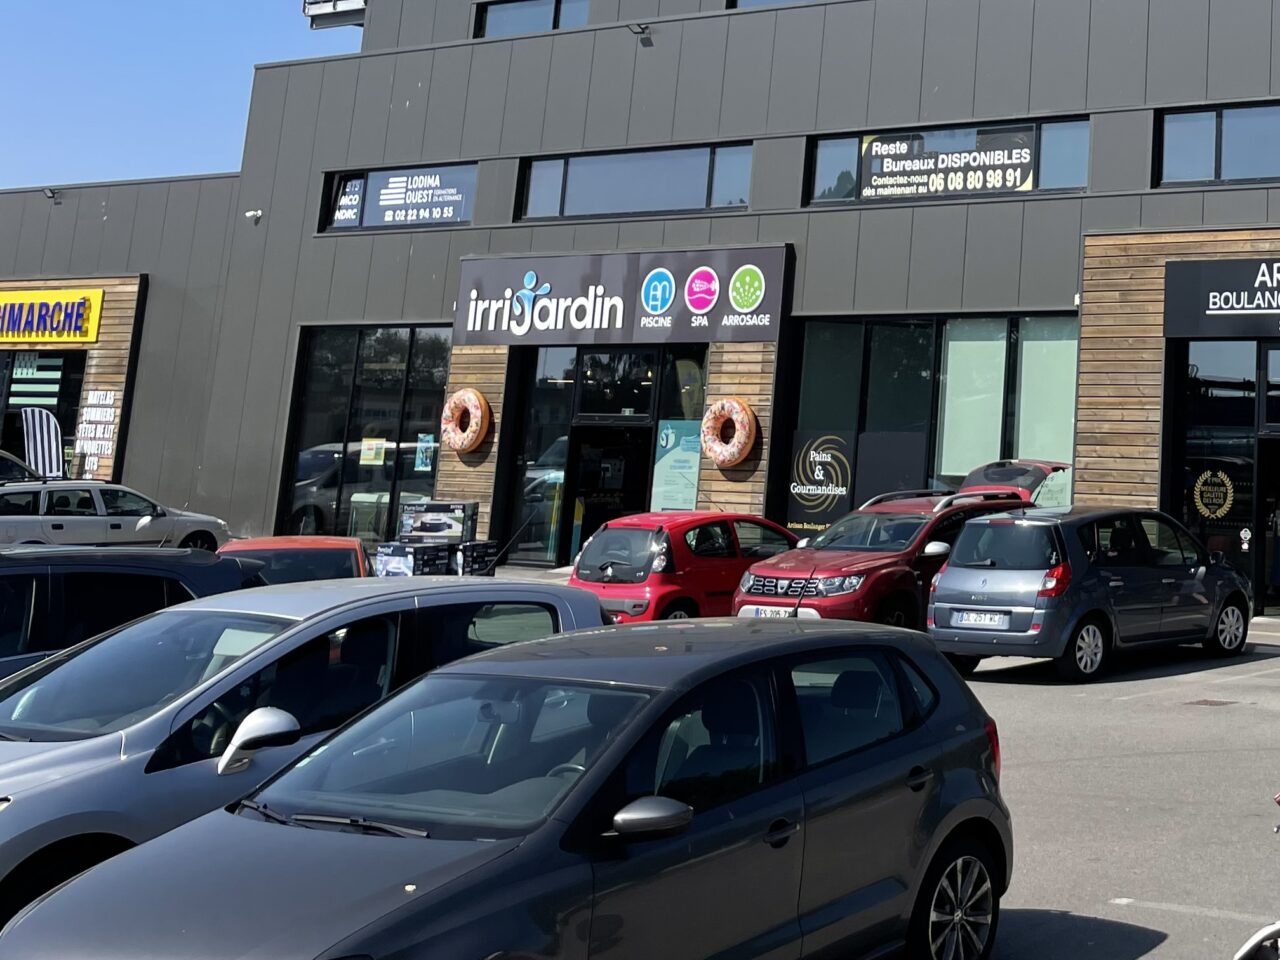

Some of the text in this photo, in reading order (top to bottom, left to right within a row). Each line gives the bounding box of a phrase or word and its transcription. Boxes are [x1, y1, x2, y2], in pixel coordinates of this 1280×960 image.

[871, 141, 908, 156] Reste
[882, 148, 1031, 173] Bureaux DISPONIBLES
[407, 174, 441, 189] LODIMA
[871, 174, 929, 187] Contactez-nous
[928, 167, 1021, 192] 06 08 80 98 91
[339, 194, 360, 206] MCO
[405, 189, 434, 204] OUEST
[0, 296, 87, 332] IMARCHÉ
[690, 315, 709, 327] SPA
[721, 313, 771, 327] ARROSAGE
[640, 316, 672, 328] PISCINE
[809, 450, 832, 462] Pains
[814, 465, 825, 480] &
[790, 482, 847, 495] Gourmandises
